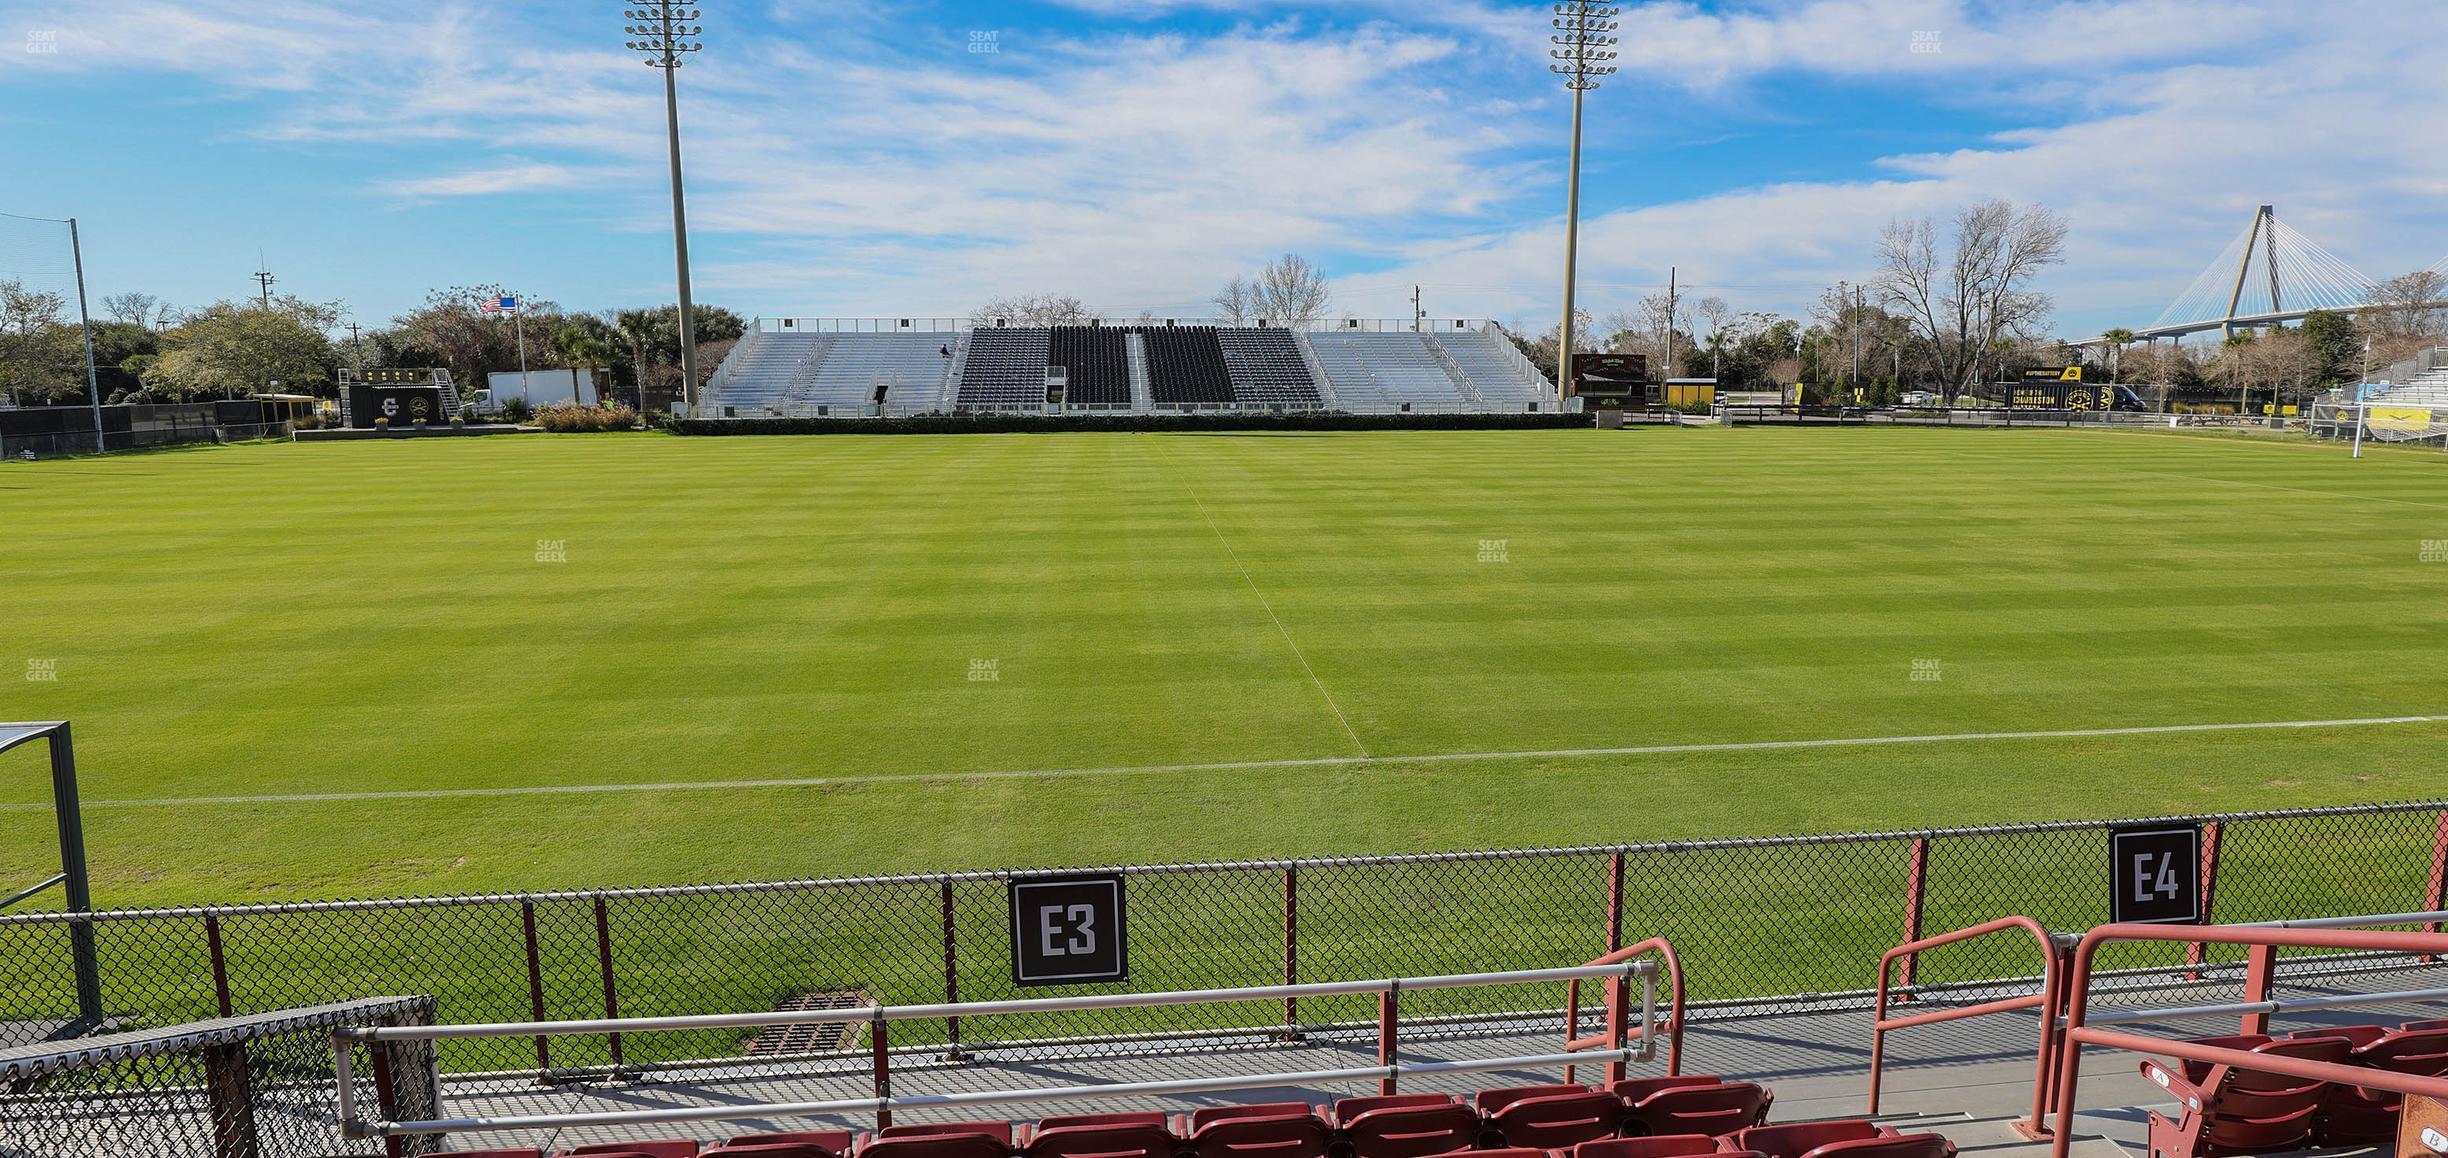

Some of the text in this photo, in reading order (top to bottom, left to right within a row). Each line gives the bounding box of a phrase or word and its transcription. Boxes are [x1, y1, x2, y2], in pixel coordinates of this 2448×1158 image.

[2134, 852, 2178, 901] E4
[1041, 904, 1095, 956] E3
[2429, 1133, 2440, 1146] B
